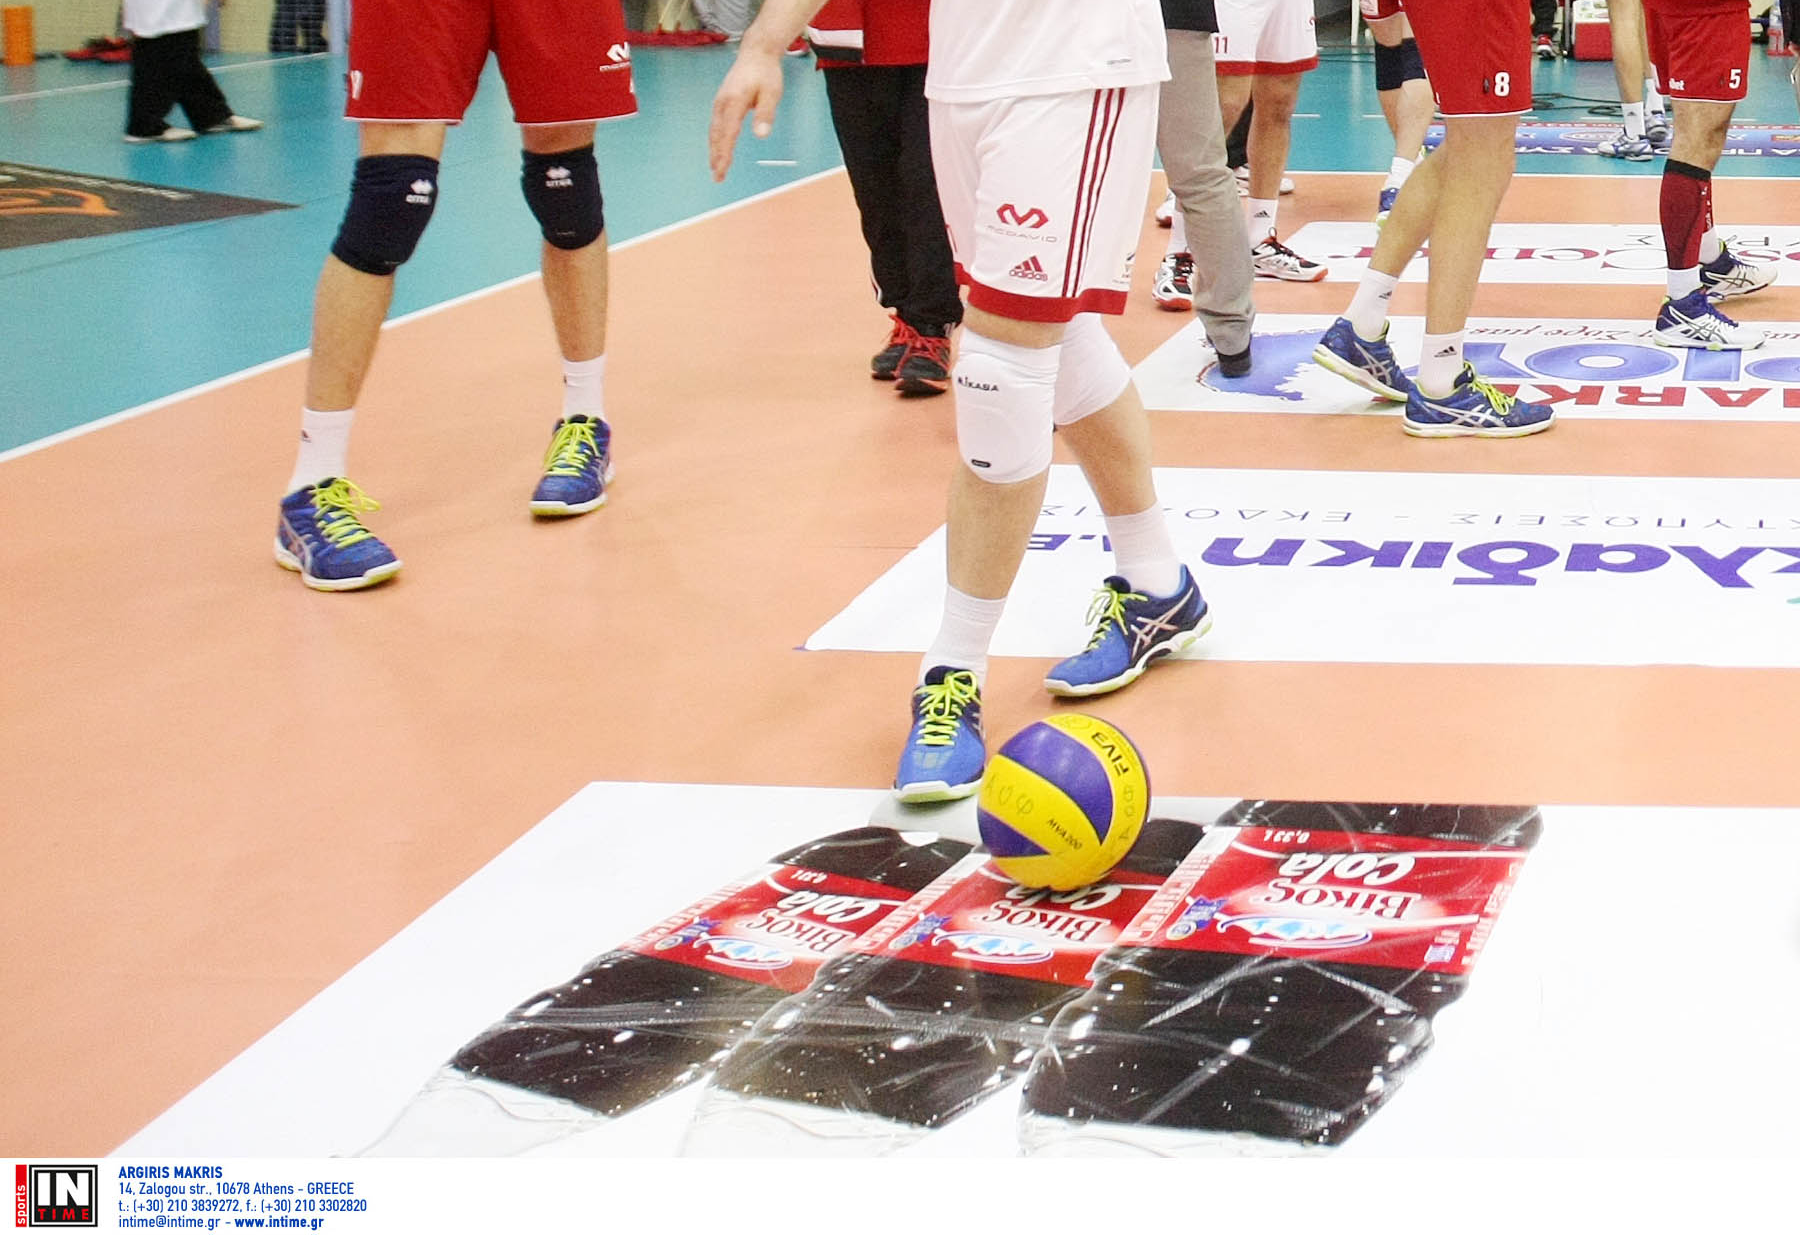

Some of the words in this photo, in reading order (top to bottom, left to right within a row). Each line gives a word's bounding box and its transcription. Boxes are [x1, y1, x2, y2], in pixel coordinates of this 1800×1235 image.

[1494, 71, 1510, 97] 8
[1728, 69, 1742, 90] 5
[1328, 246, 1669, 270] Cenr
[1008, 268, 1048, 282] adidas
[1036, 504, 1352, 524] ΕΚΔΟΙΣ
[1278, 852, 1416, 887] Cola
[776, 890, 881, 924] Cola
